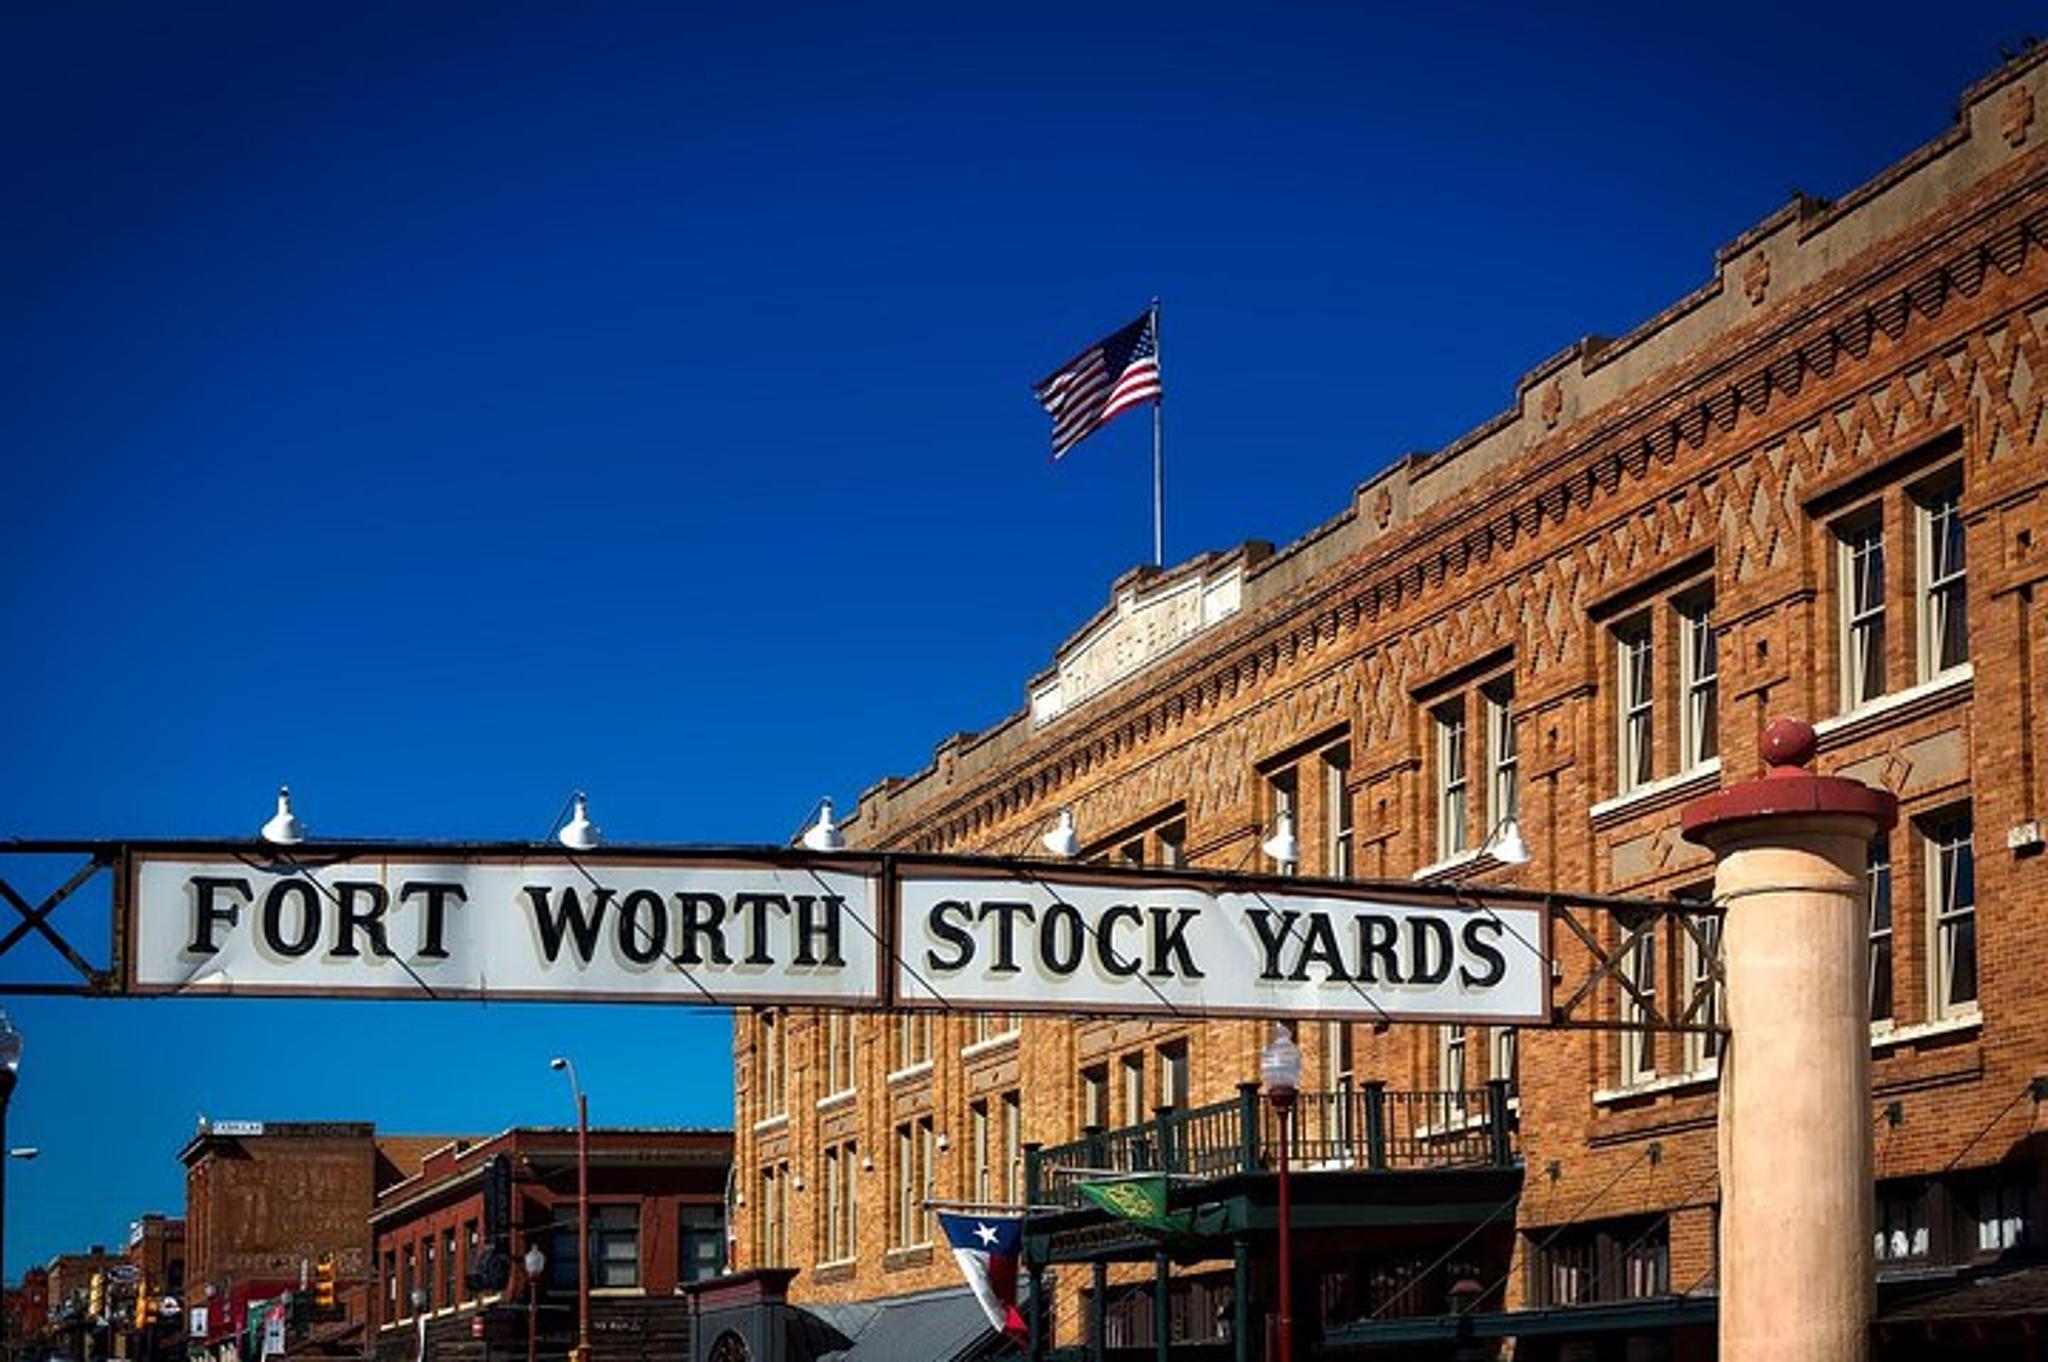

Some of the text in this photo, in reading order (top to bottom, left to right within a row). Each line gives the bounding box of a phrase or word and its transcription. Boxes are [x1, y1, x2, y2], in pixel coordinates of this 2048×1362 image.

[187, 876, 1506, 988] FORT WORTH STOCK YARDS
